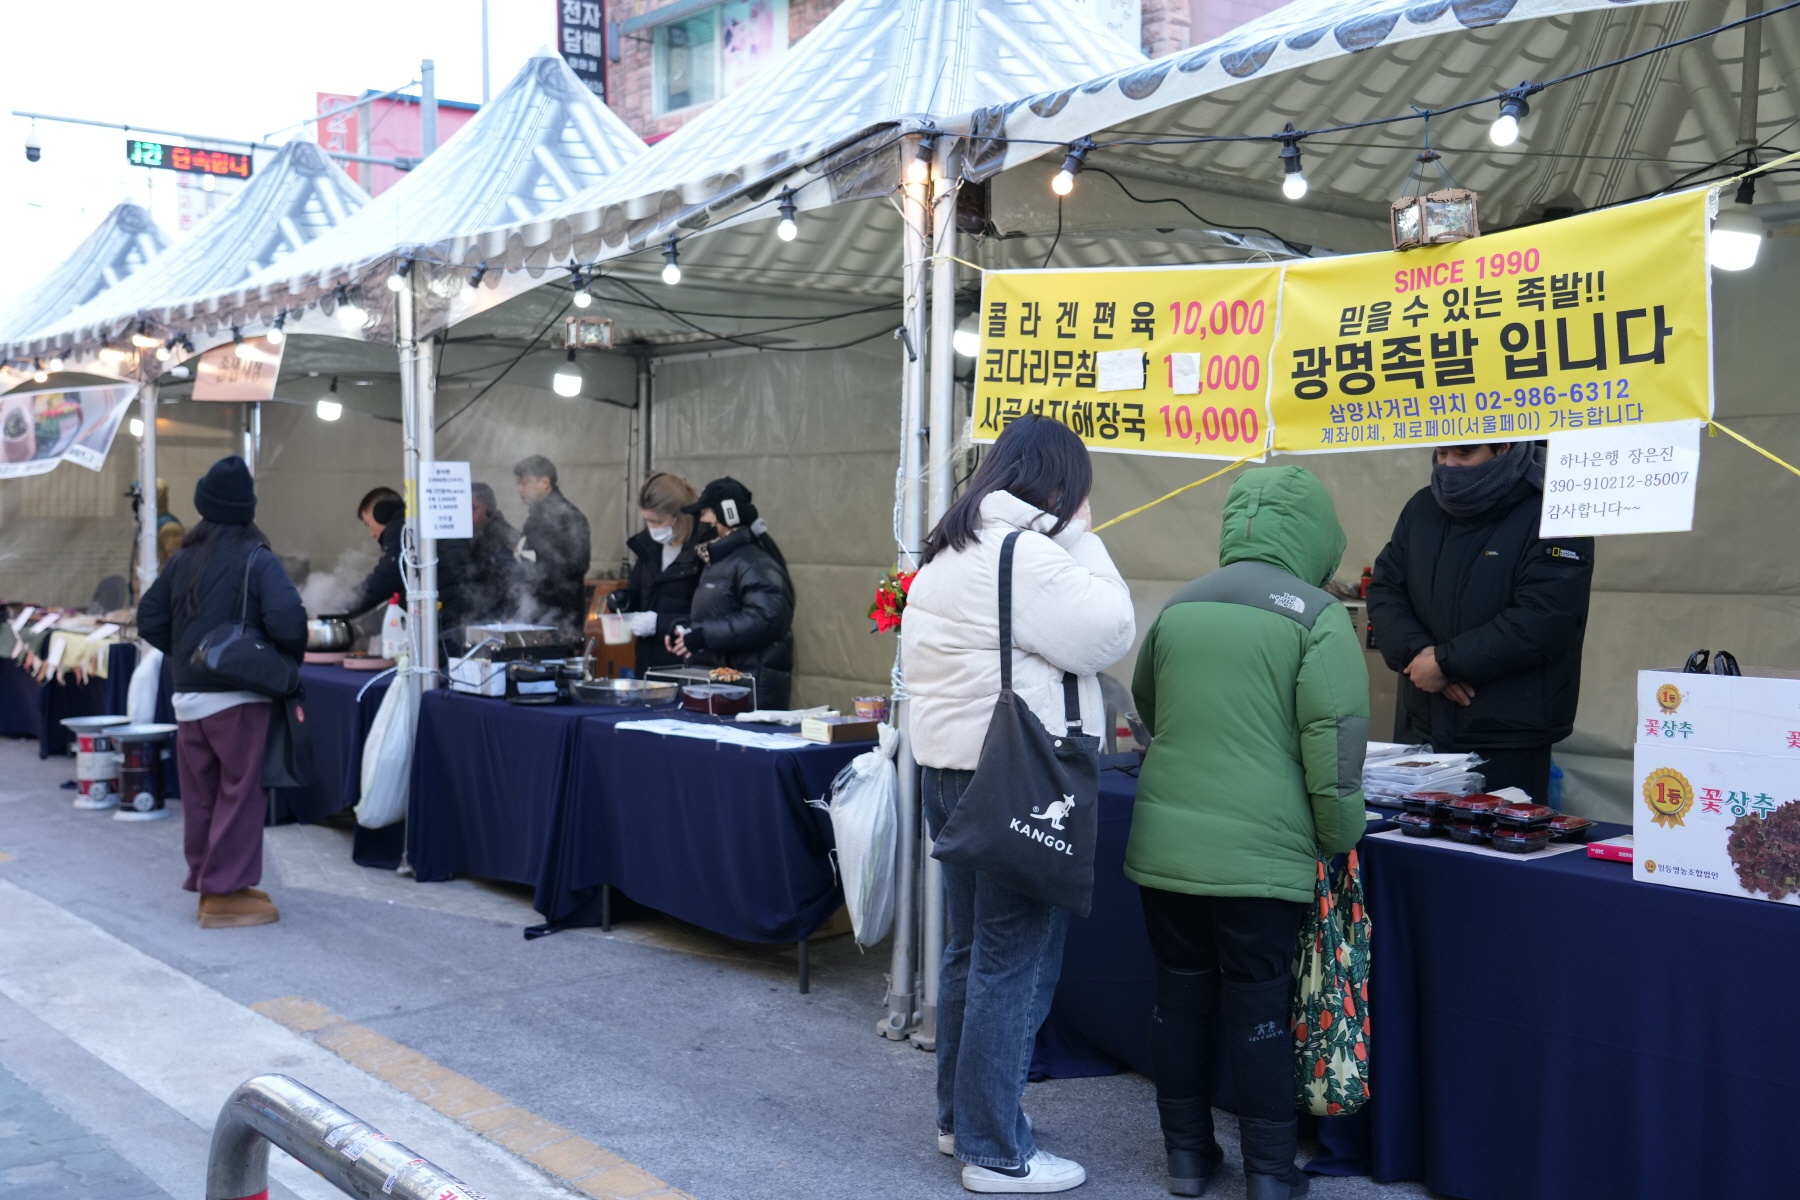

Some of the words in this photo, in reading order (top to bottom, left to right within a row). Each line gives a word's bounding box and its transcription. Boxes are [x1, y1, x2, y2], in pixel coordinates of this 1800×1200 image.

[562, 0, 602, 28] 전자
[562, 27, 602, 57] 담배
[171, 147, 249, 177] 단속합니
[1394, 260, 1464, 293] SINCE
[1475, 248, 1541, 280] 1990
[1338, 300, 1392, 337] 믿을
[1402, 295, 1429, 327] 수
[1442, 286, 1503, 324] 있는
[1515, 270, 1606, 311] 족발!!
[1169, 299, 1265, 340] 10,000
[1291, 328, 1479, 400] 광명족발
[1500, 305, 1673, 380] 입니다
[1163, 354, 1260, 395] 1,000
[1329, 396, 1421, 424] 삼양사거리
[1429, 391, 1466, 416] 위치
[1475, 378, 1630, 412] 02-986-6312
[1159, 405, 1259, 445] 10,000
[1320, 423, 1386, 445] 계좌이체,
[1392, 411, 1540, 438] 제로페이(서울페이)
[1549, 403, 1644, 429] 가능합니다
[1560, 450, 1619, 468] 하나은행
[1628, 446, 1674, 464] 장은진
[1549, 471, 1689, 493] 390-910212-85007
[1547, 501, 1641, 520] 감사합니다~~
[1269, 593, 1295, 605] NORTH
[1274, 599, 1293, 609] FACE
[1283, 592, 1297, 600] THE
[1662, 691, 1677, 703] 1등
[1644, 718, 1694, 739] 꽃상추
[1656, 783, 1683, 805] 1등
[1699, 787, 1777, 820] 꽃상추
[1009, 817, 1074, 856] KANGOL
